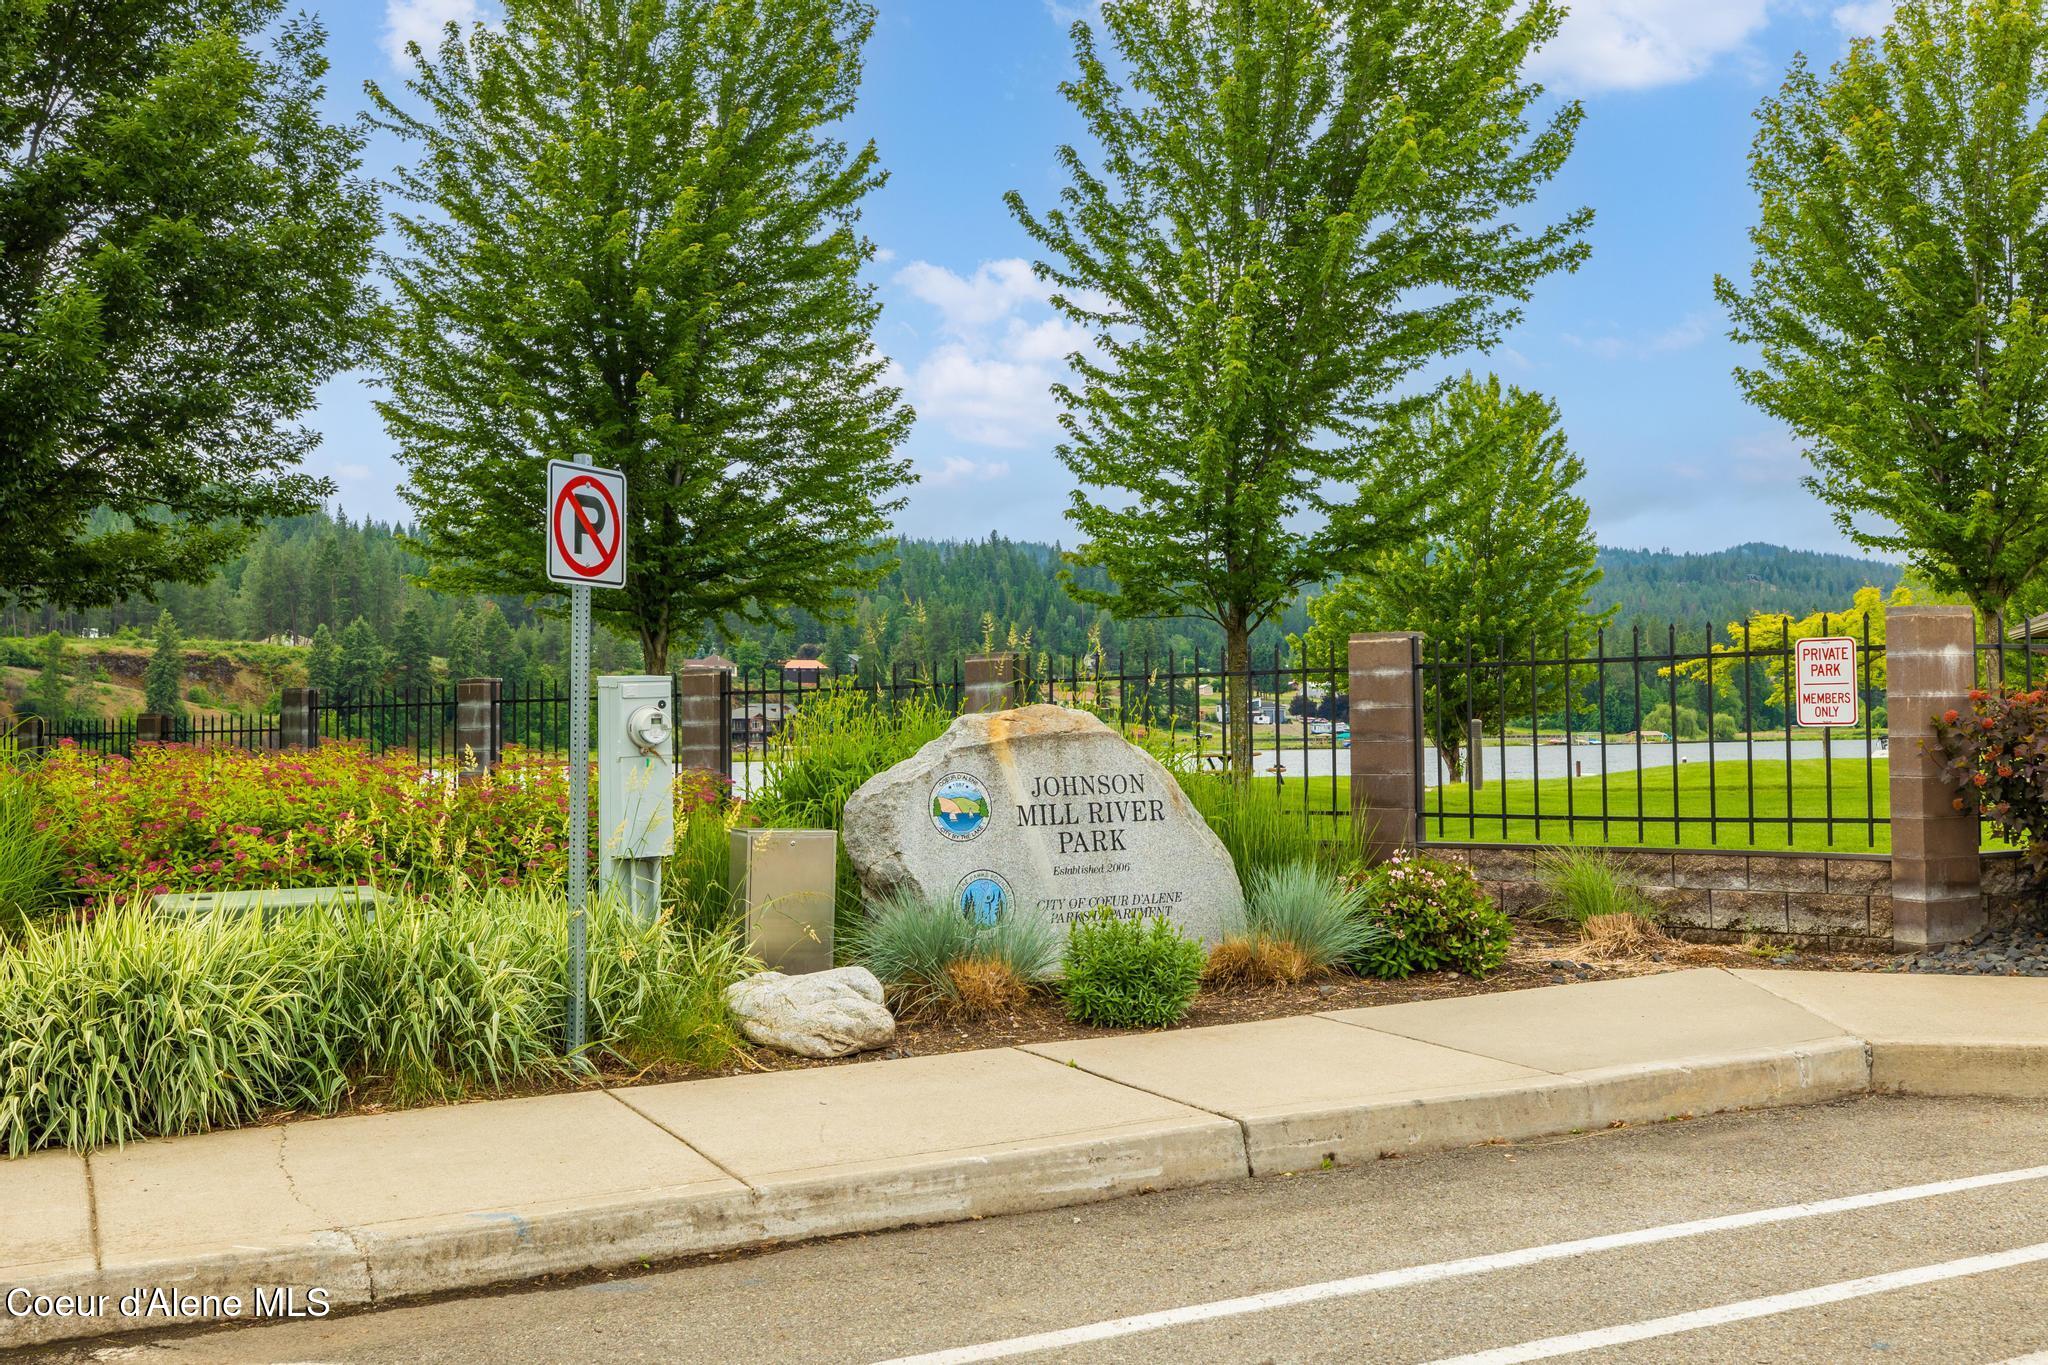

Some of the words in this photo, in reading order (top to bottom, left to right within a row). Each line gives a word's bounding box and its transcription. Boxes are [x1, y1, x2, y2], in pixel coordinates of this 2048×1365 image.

[1802, 647, 1849, 661] PRIVATE
[1810, 663, 1841, 677] PARK
[1802, 692, 1851, 704] MEMBERS
[1814, 706, 1840, 718] ONLY
[1031, 773, 1145, 798] JOHNSON
[1016, 802, 1080, 827] MILL
[1088, 799, 1166, 824] RIVER
[1058, 829, 1127, 854] PARK
[1053, 864, 1105, 876] Established
[1106, 862, 1131, 873] 2006
[1036, 899, 1066, 911] CITY
[1068, 897, 1086, 909] OF
[1088, 894, 1129, 908] COEUR
[1132, 891, 1183, 906] D'ALENE
[1050, 910, 1090, 924] PARKS
[1092, 905, 1173, 921] DPARTMENT
